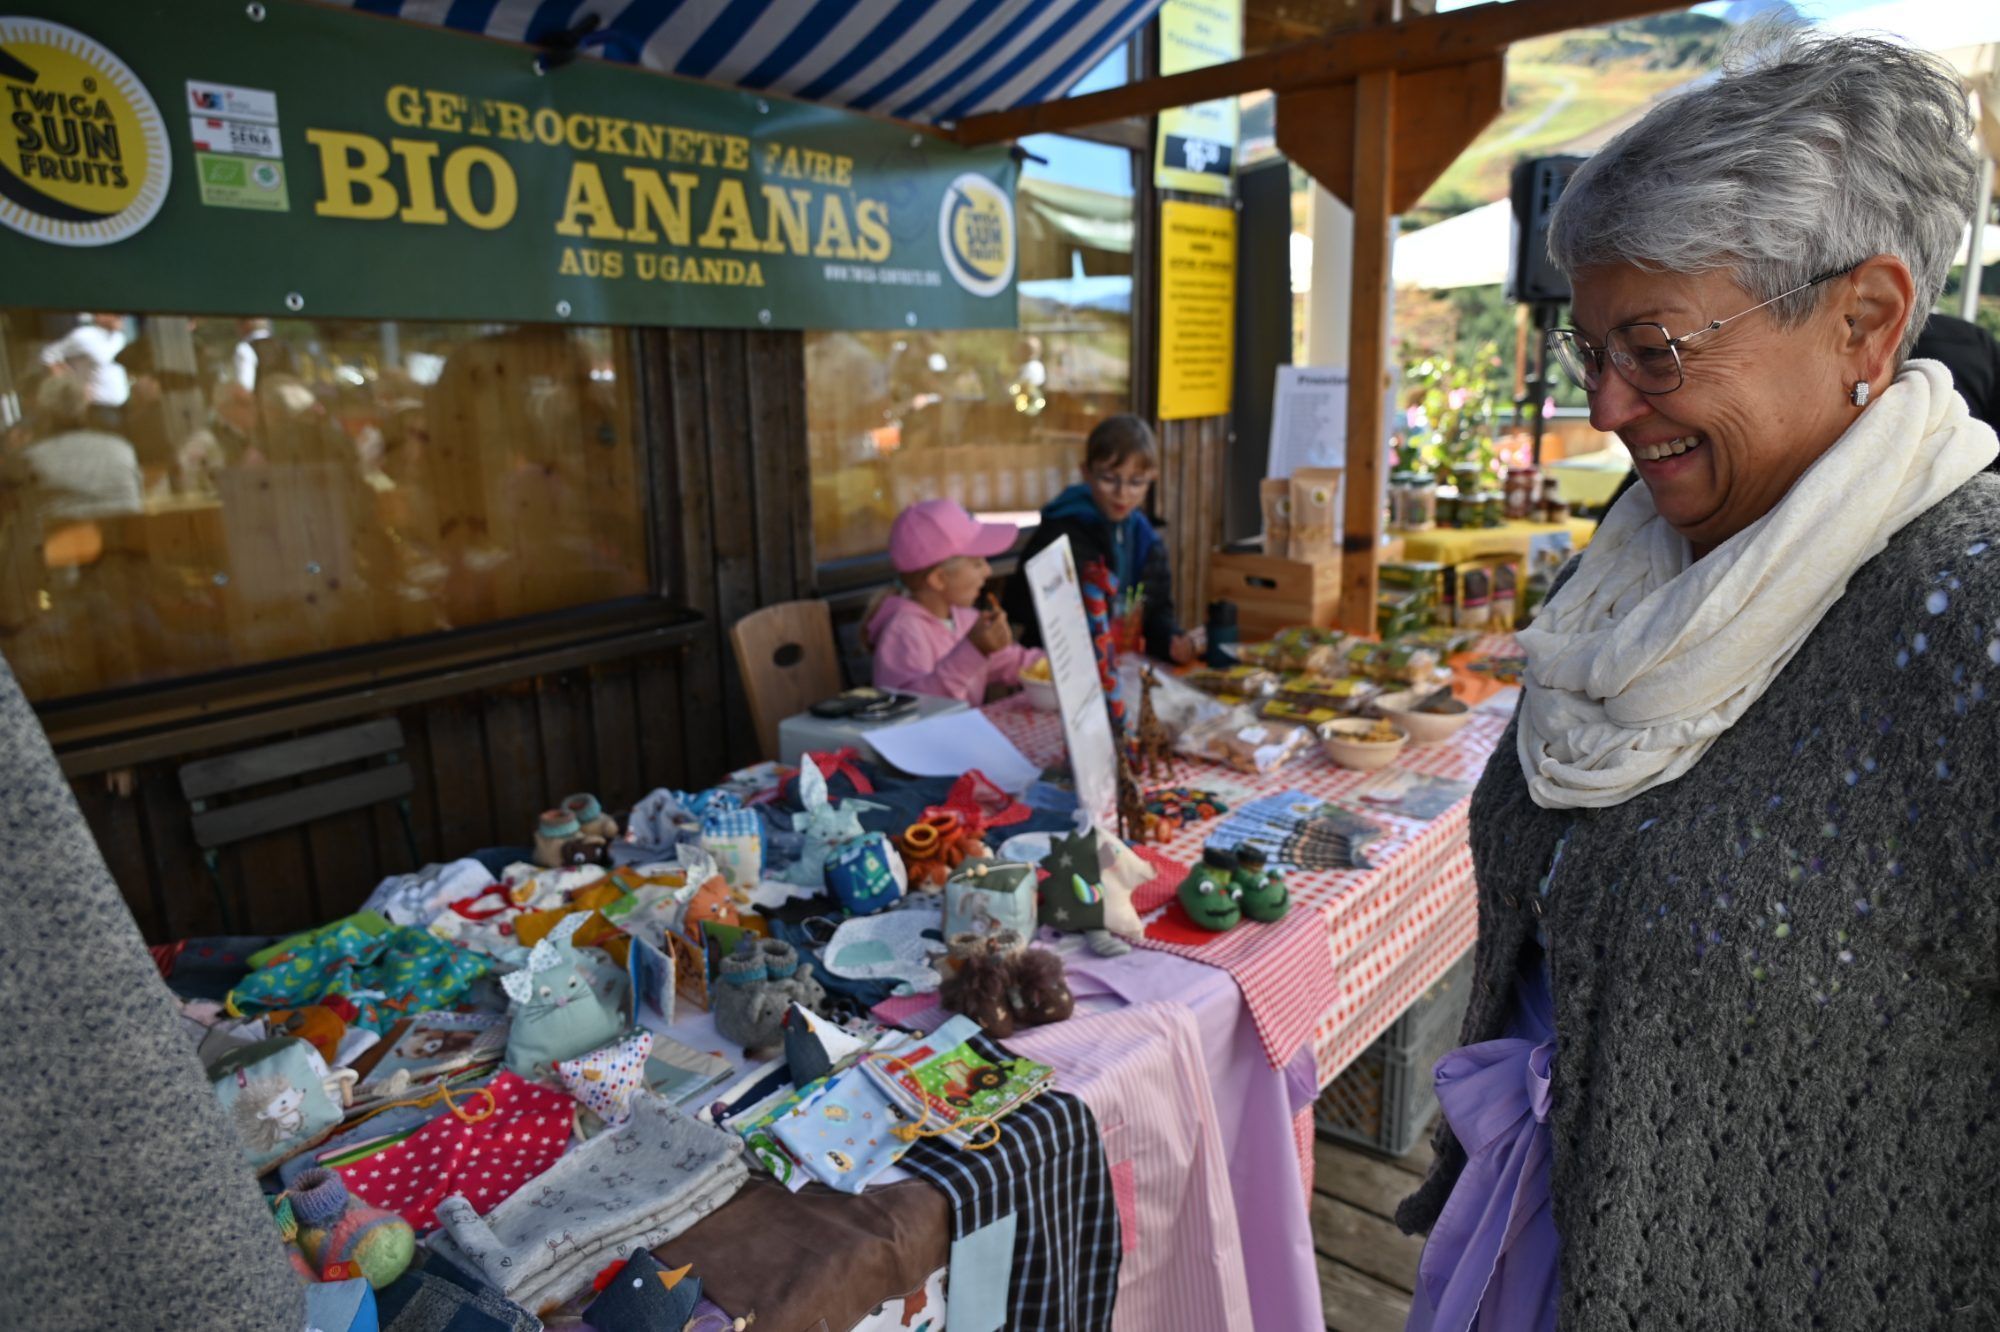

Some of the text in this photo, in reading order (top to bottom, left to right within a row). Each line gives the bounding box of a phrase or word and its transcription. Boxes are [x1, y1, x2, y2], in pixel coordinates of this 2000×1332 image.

[6, 83, 114, 121] TWIGA
[11, 110, 122, 161] SUN
[386, 85, 854, 187] GETROCKNETE FAIRE
[20, 154, 128, 188] FRUITS
[306, 129, 891, 262] BIO ANANAS
[560, 247, 764, 288] AUS UGANDA
